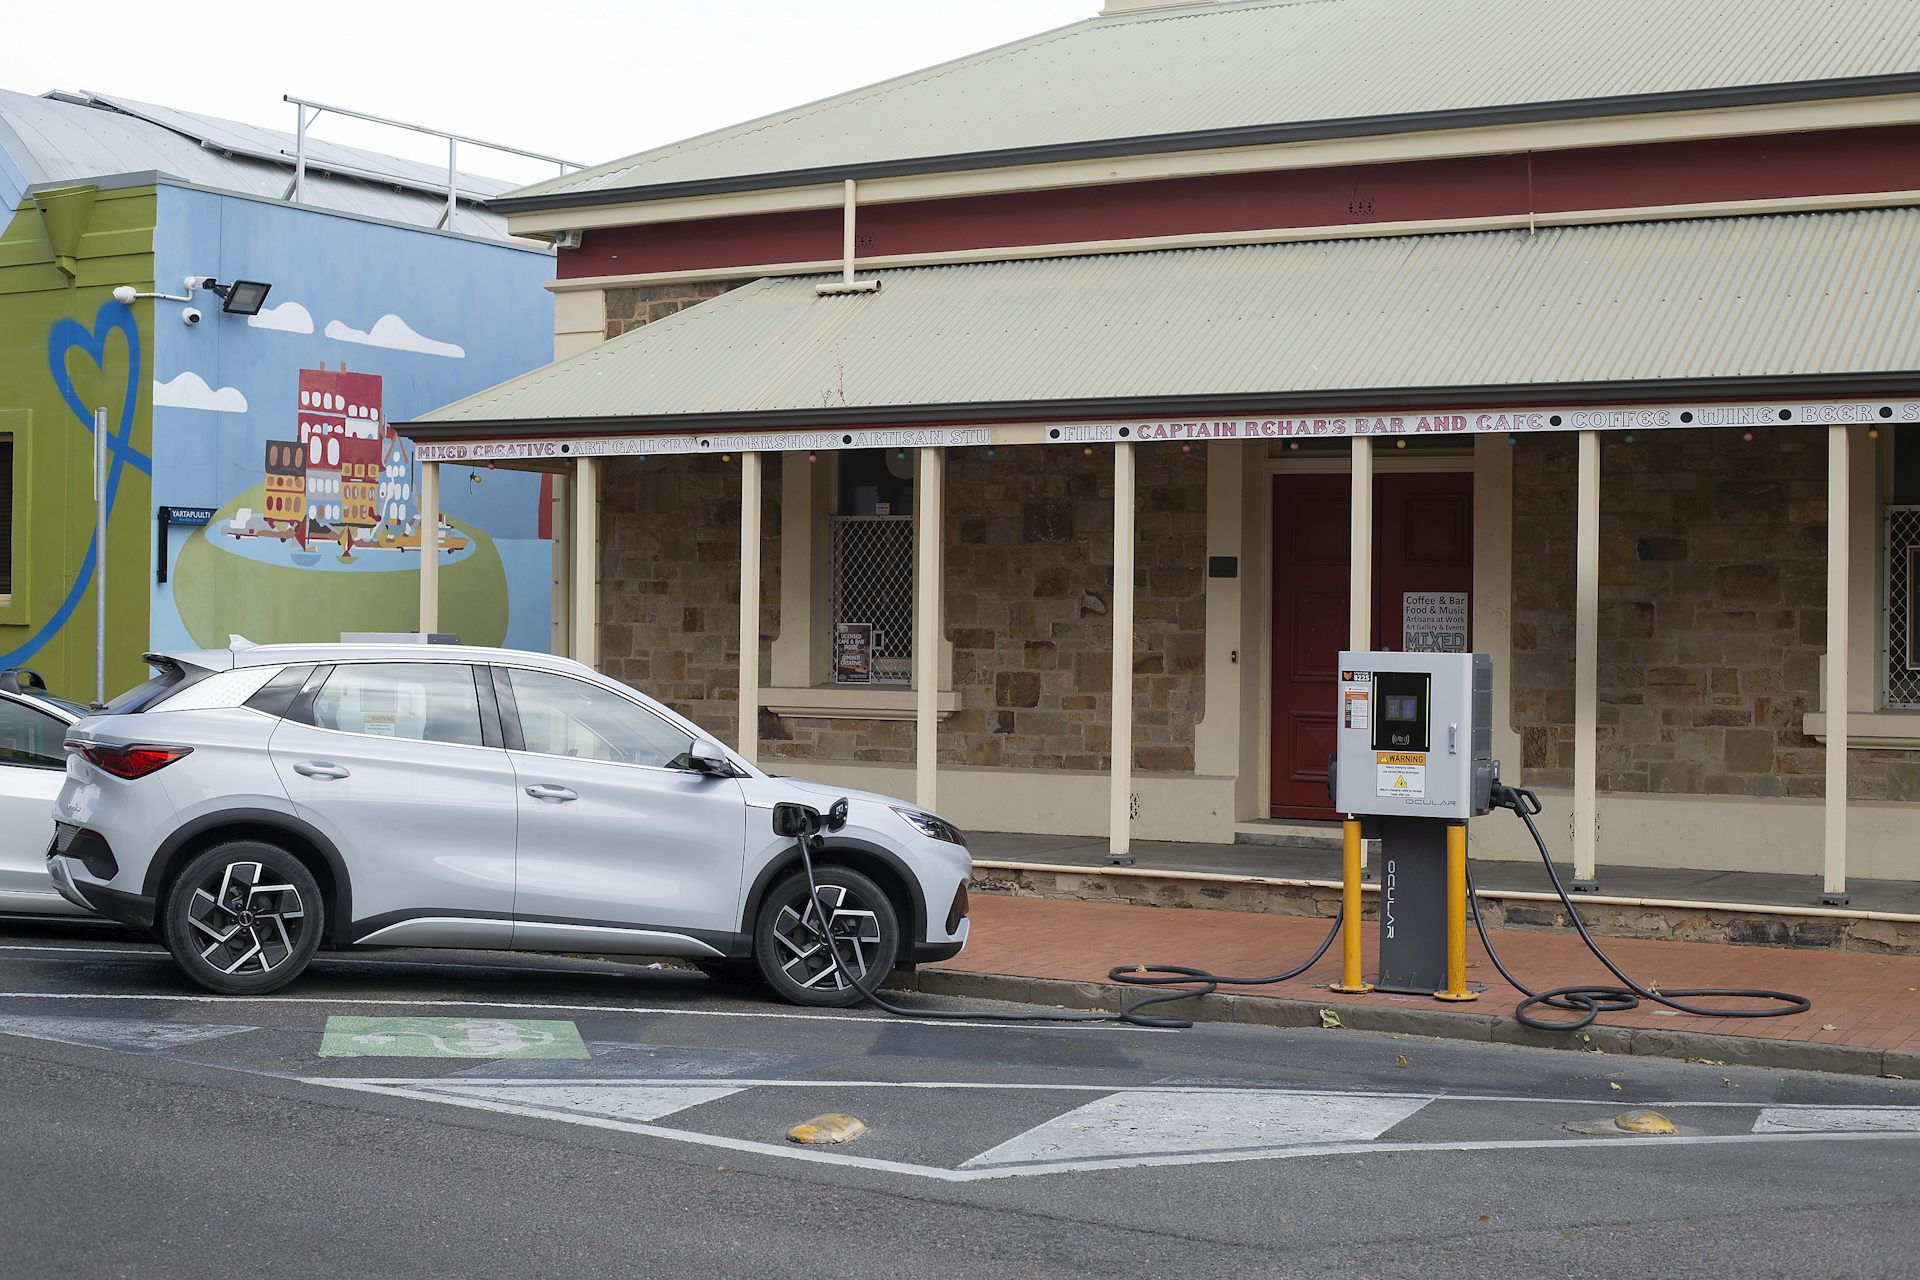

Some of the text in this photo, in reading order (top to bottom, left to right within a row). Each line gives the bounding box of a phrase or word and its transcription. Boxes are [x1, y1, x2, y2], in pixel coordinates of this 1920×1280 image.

[1570, 409, 1671, 428] COFFEE
[1697, 406, 1774, 425] WINE
[1800, 404, 1874, 423] BEER
[1063, 425, 1113, 441] FILM
[1136, 413, 1543, 440] CAPTAIN REHAB'S BAR AND CAFE
[855, 428, 990, 447] ARTISAN STU
[417, 442, 556, 459] MIXED CREATIVE
[572, 441, 607, 455] ART
[172, 510, 211, 519] YARTAPUULTI
[1406, 596, 1465, 605] Coffee & Bar
[1406, 606, 1465, 614] Food & Music
[1406, 615, 1435, 623] Artisans
[1405, 631, 1465, 649] MIXED
[1388, 754, 1424, 764] WARNING
[1405, 798, 1457, 806] OCULAR
[1386, 860, 1396, 939] OCULAR
